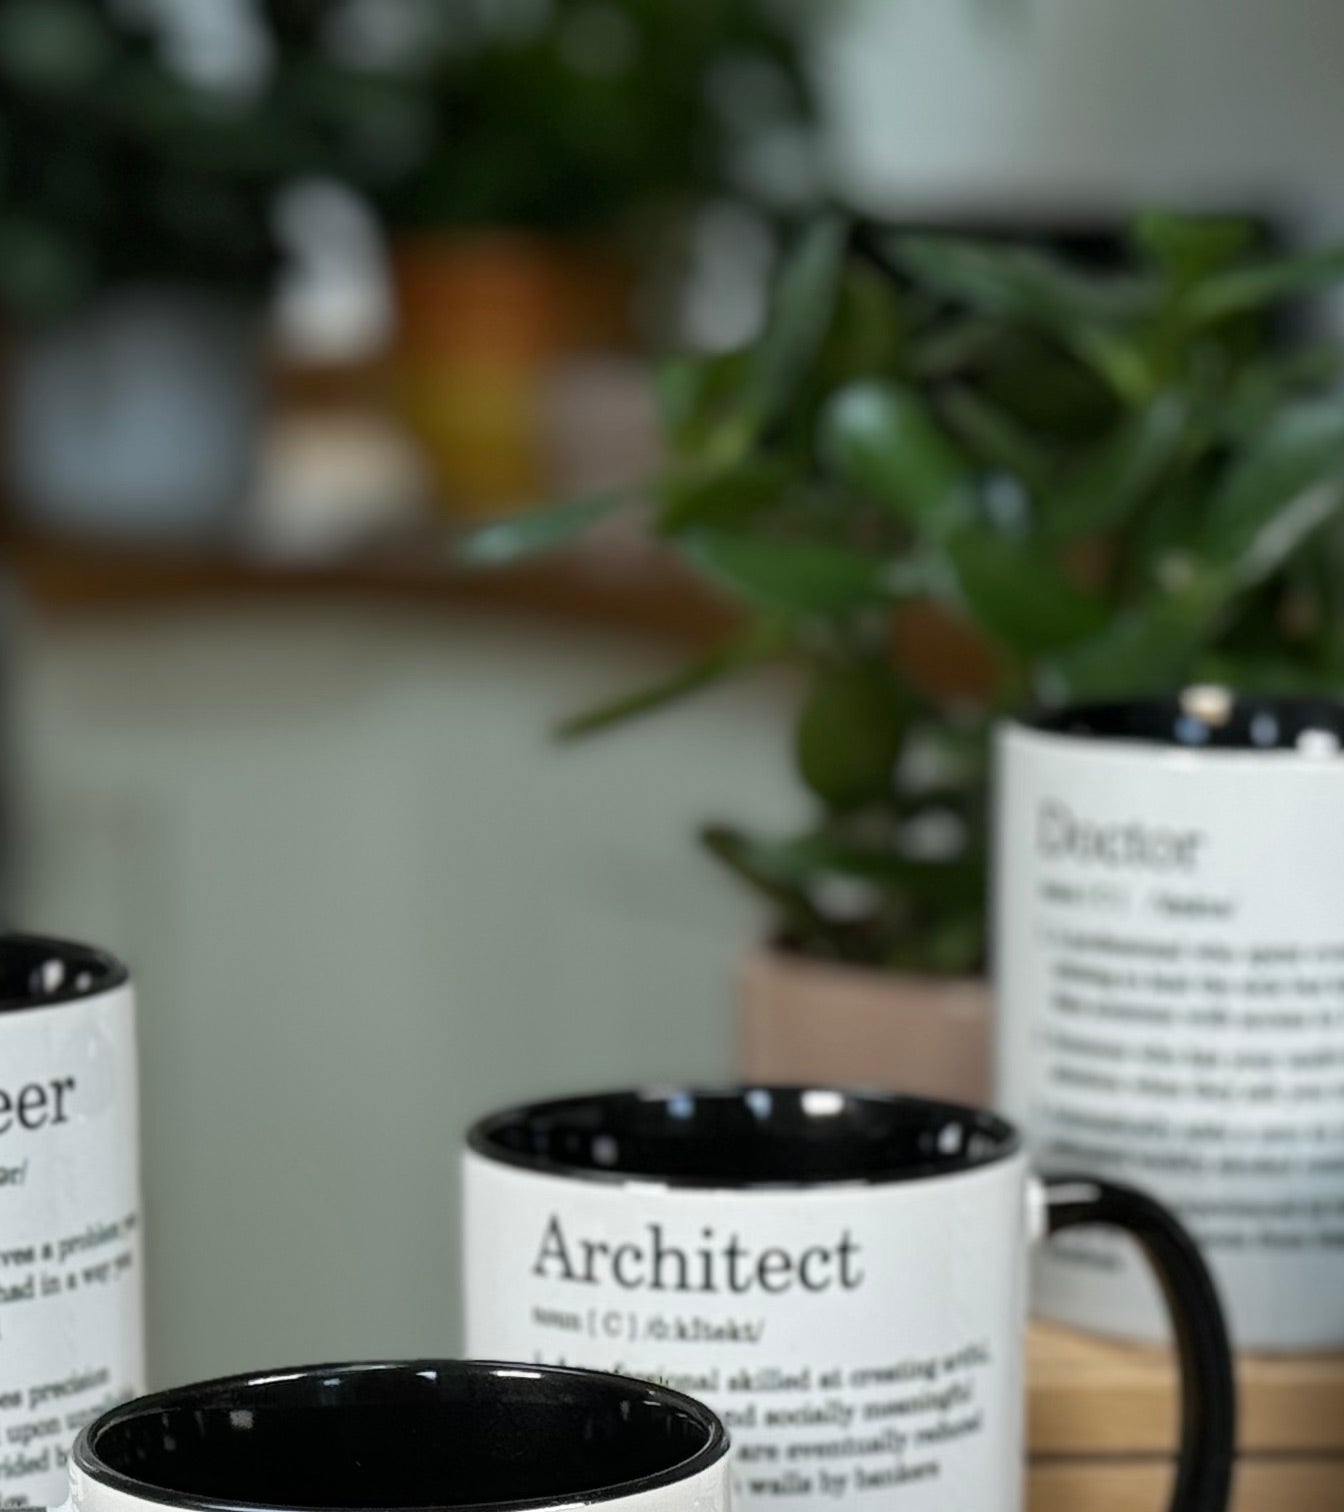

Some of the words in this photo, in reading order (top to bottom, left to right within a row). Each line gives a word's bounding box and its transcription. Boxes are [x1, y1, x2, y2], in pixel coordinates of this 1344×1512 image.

[41, 1245, 53, 1261] a
[531, 1212, 864, 1295] Architect
[40, 1274, 60, 1297] in
